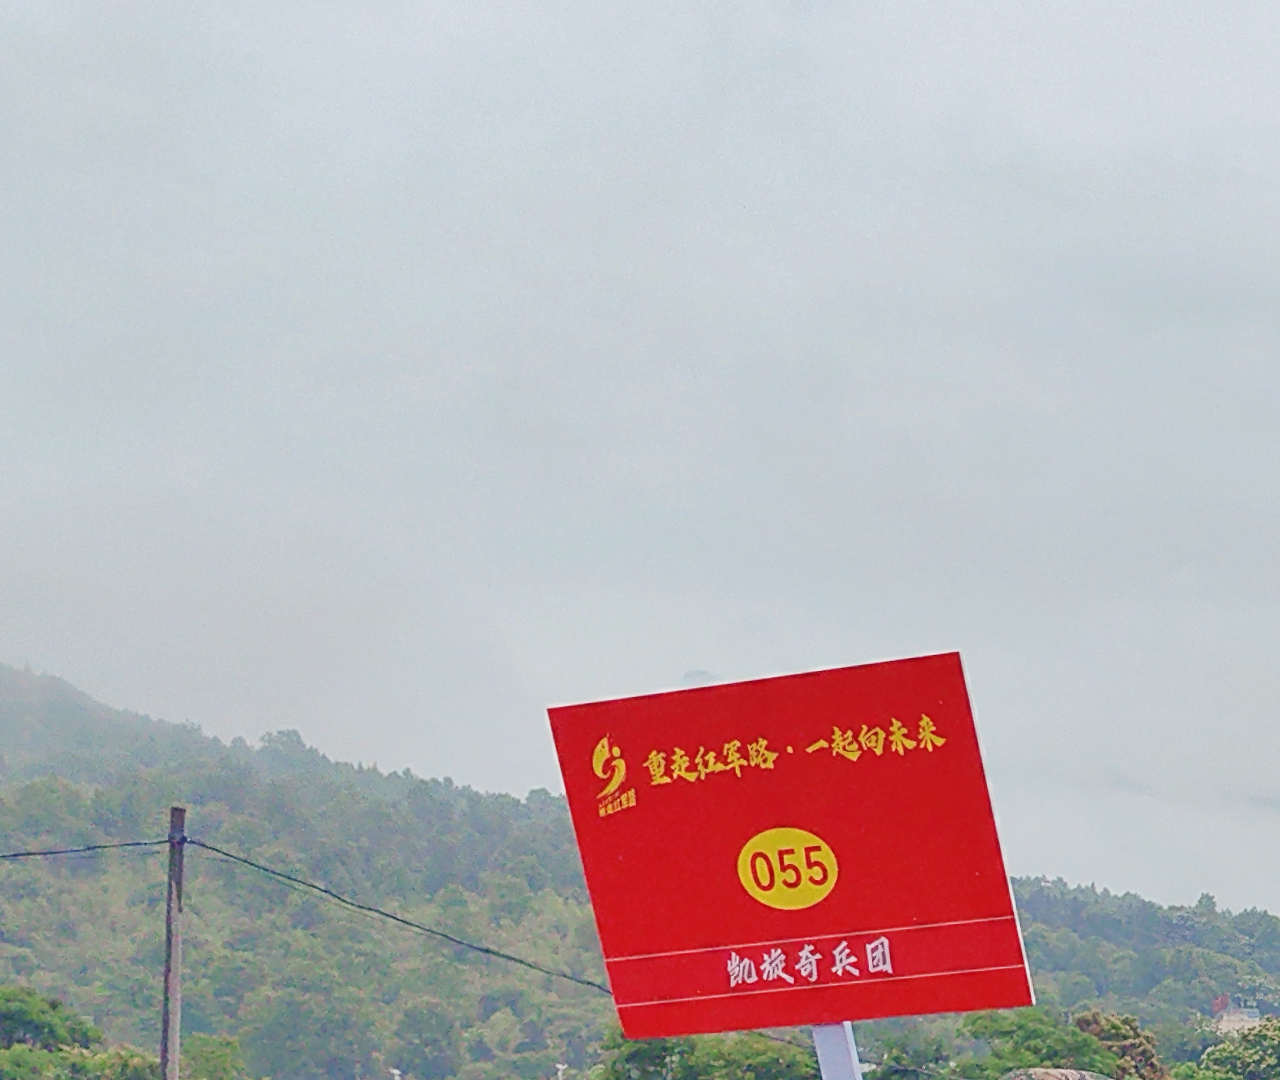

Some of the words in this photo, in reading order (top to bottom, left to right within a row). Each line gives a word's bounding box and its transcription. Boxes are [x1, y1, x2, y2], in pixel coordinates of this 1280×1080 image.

[750, 845, 828, 891] 055
[727, 936, 893, 987] 凯旋奇兵团
